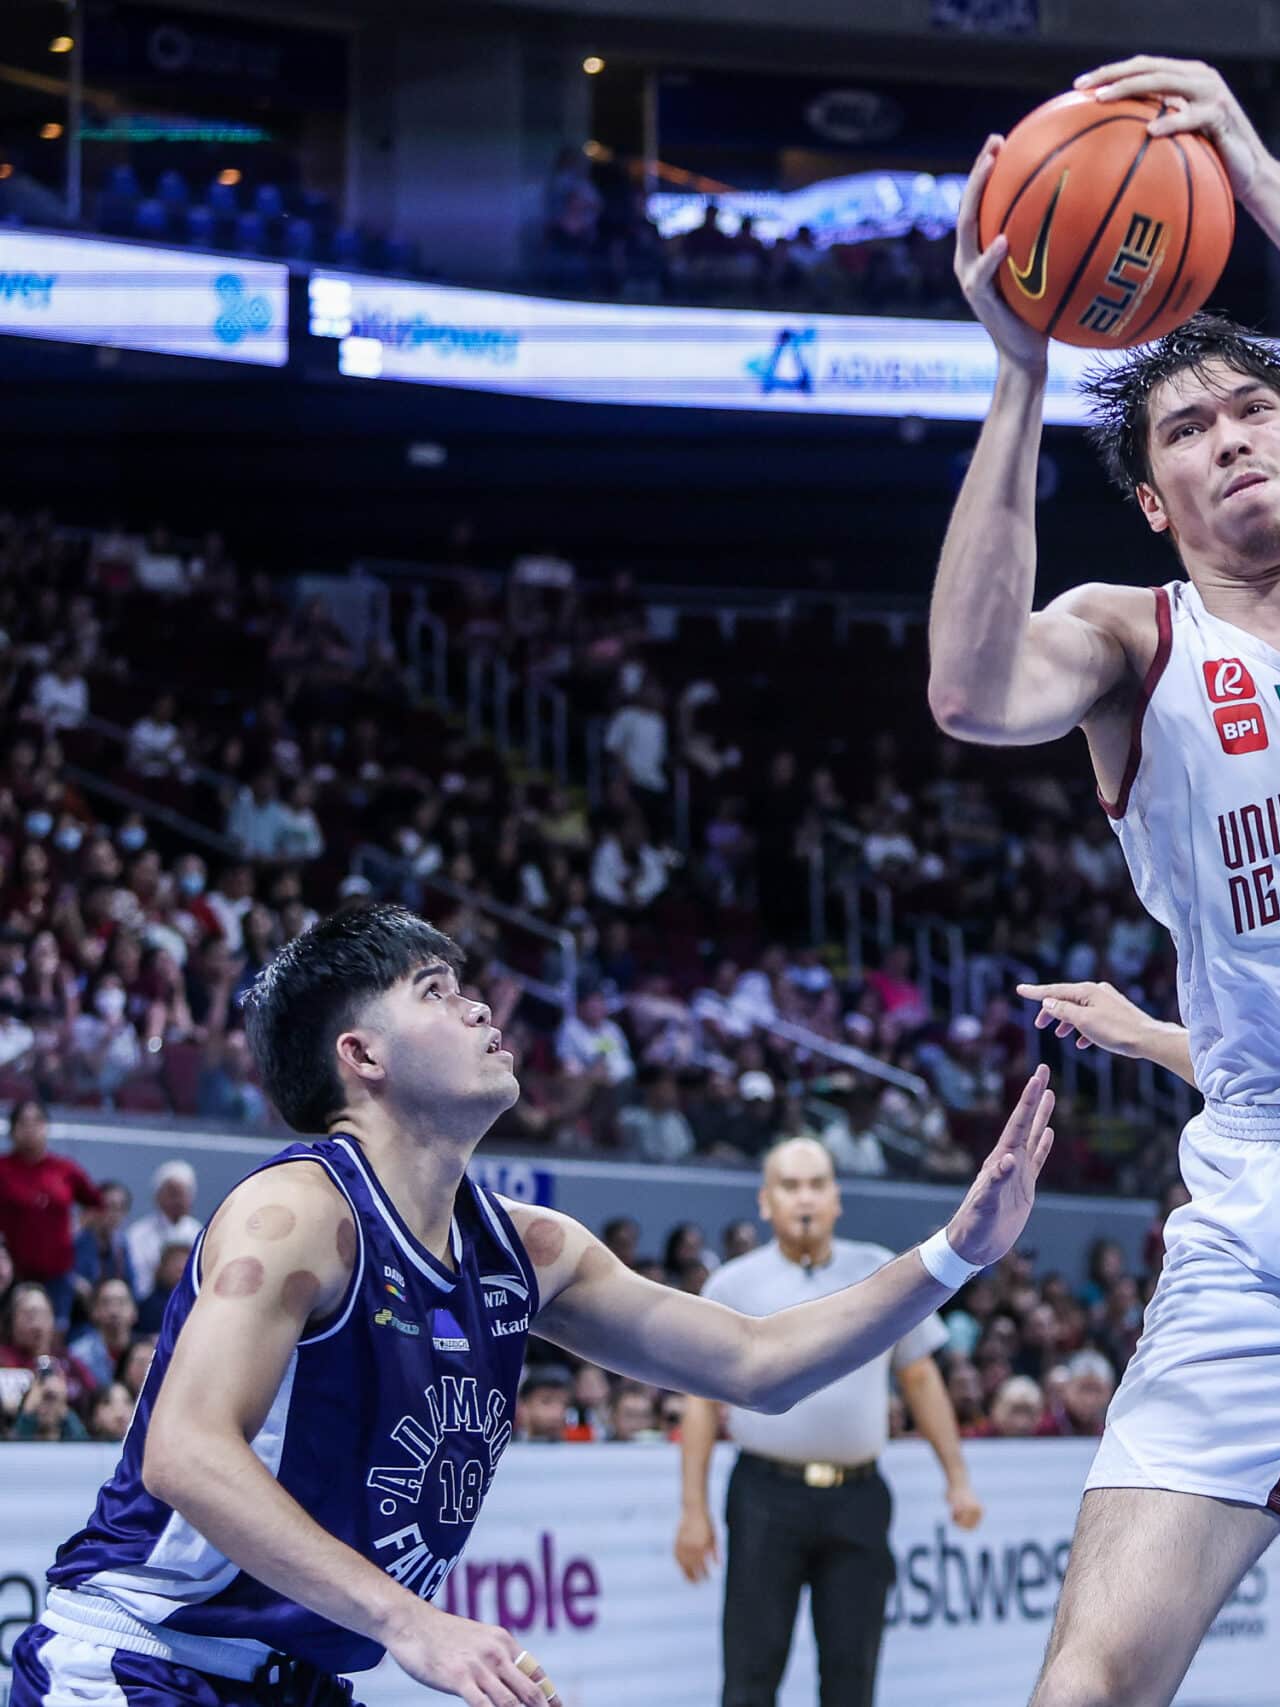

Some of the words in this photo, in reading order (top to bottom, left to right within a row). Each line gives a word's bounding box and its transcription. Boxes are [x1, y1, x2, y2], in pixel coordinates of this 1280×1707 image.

[1079, 212, 1164, 333] ELITE
[1222, 717, 1259, 741] BPI
[1228, 863, 1280, 935] NG
[483, 1290, 508, 1308] NTA
[490, 1313, 529, 1337] kari
[439, 1459, 484, 1525] 18
